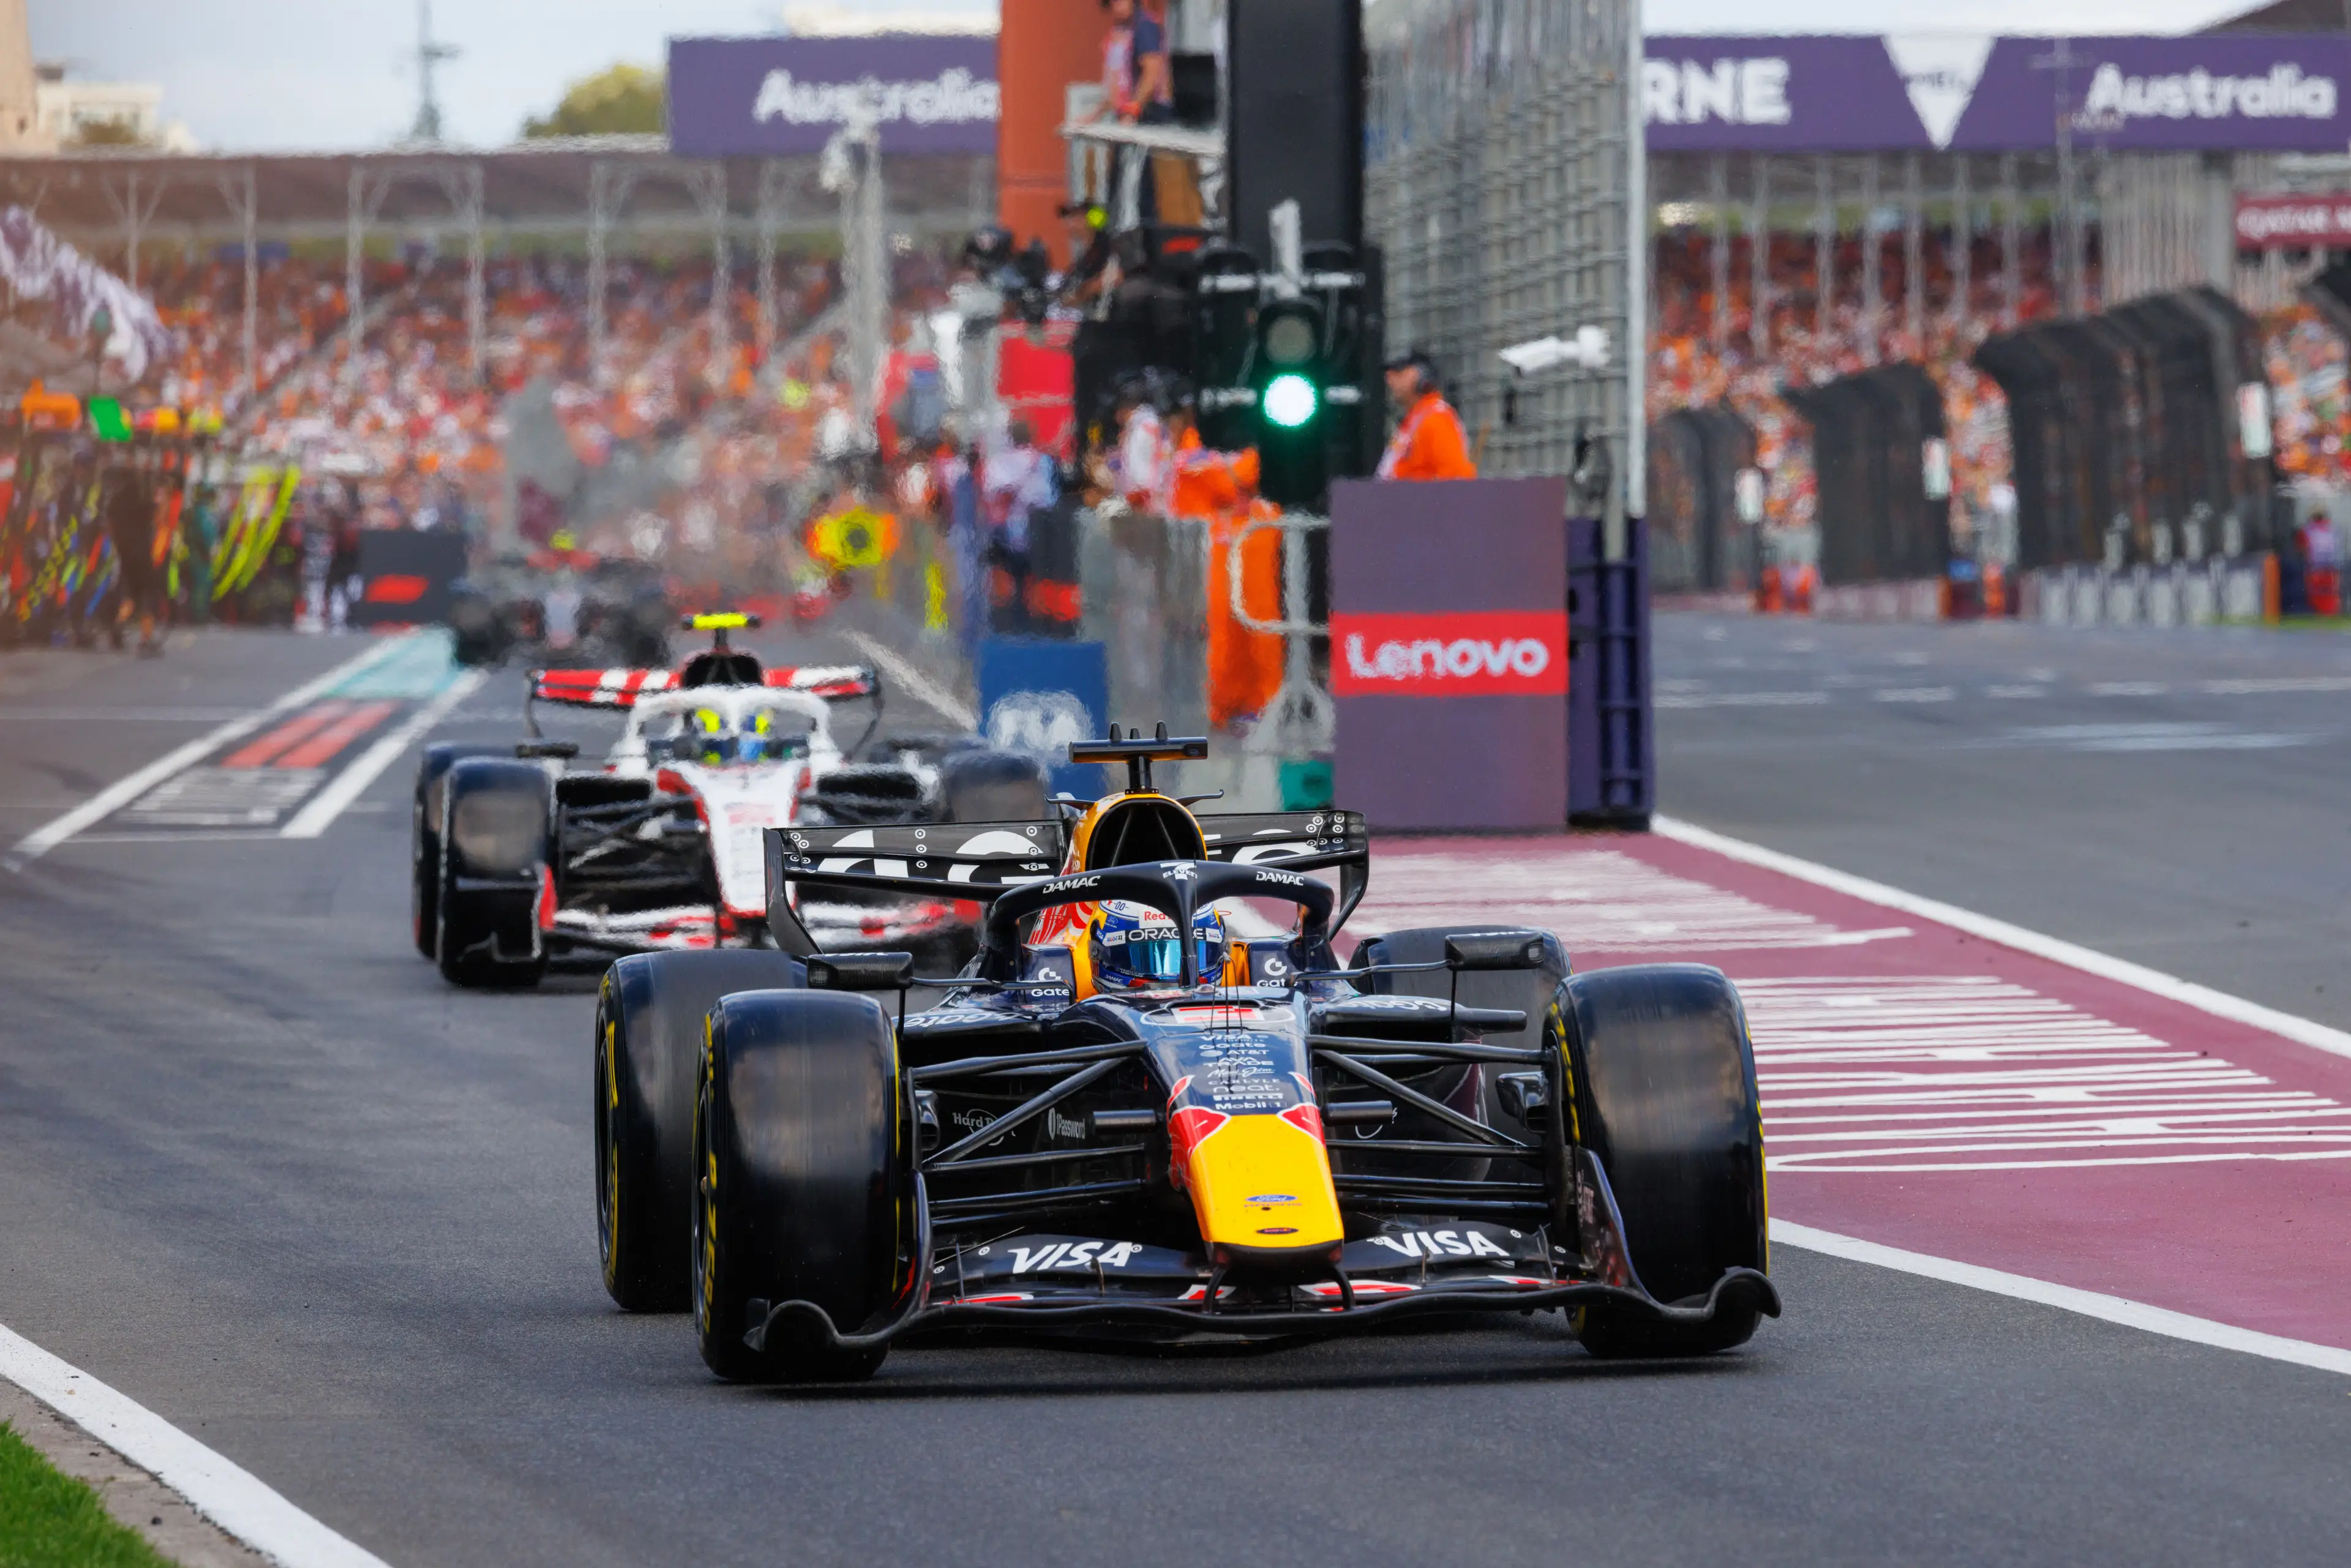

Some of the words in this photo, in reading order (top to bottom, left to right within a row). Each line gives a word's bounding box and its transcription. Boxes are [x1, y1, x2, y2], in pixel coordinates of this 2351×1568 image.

[2084, 62, 2337, 119] Australia
[1345, 632, 1549, 680] Lenovo
[1043, 875, 1101, 894] DAMAC
[1256, 871, 1304, 887] DAMAC
[1128, 928, 1204, 941] ORACE
[1031, 988, 1070, 997] Gate
[1215, 1101, 1267, 1110] Mobil
[952, 1112, 983, 1128] Hard
[1056, 1114, 1086, 1139] 1Password
[1379, 1231, 1510, 1257] VISA
[1008, 1241, 1134, 1274] VISA
